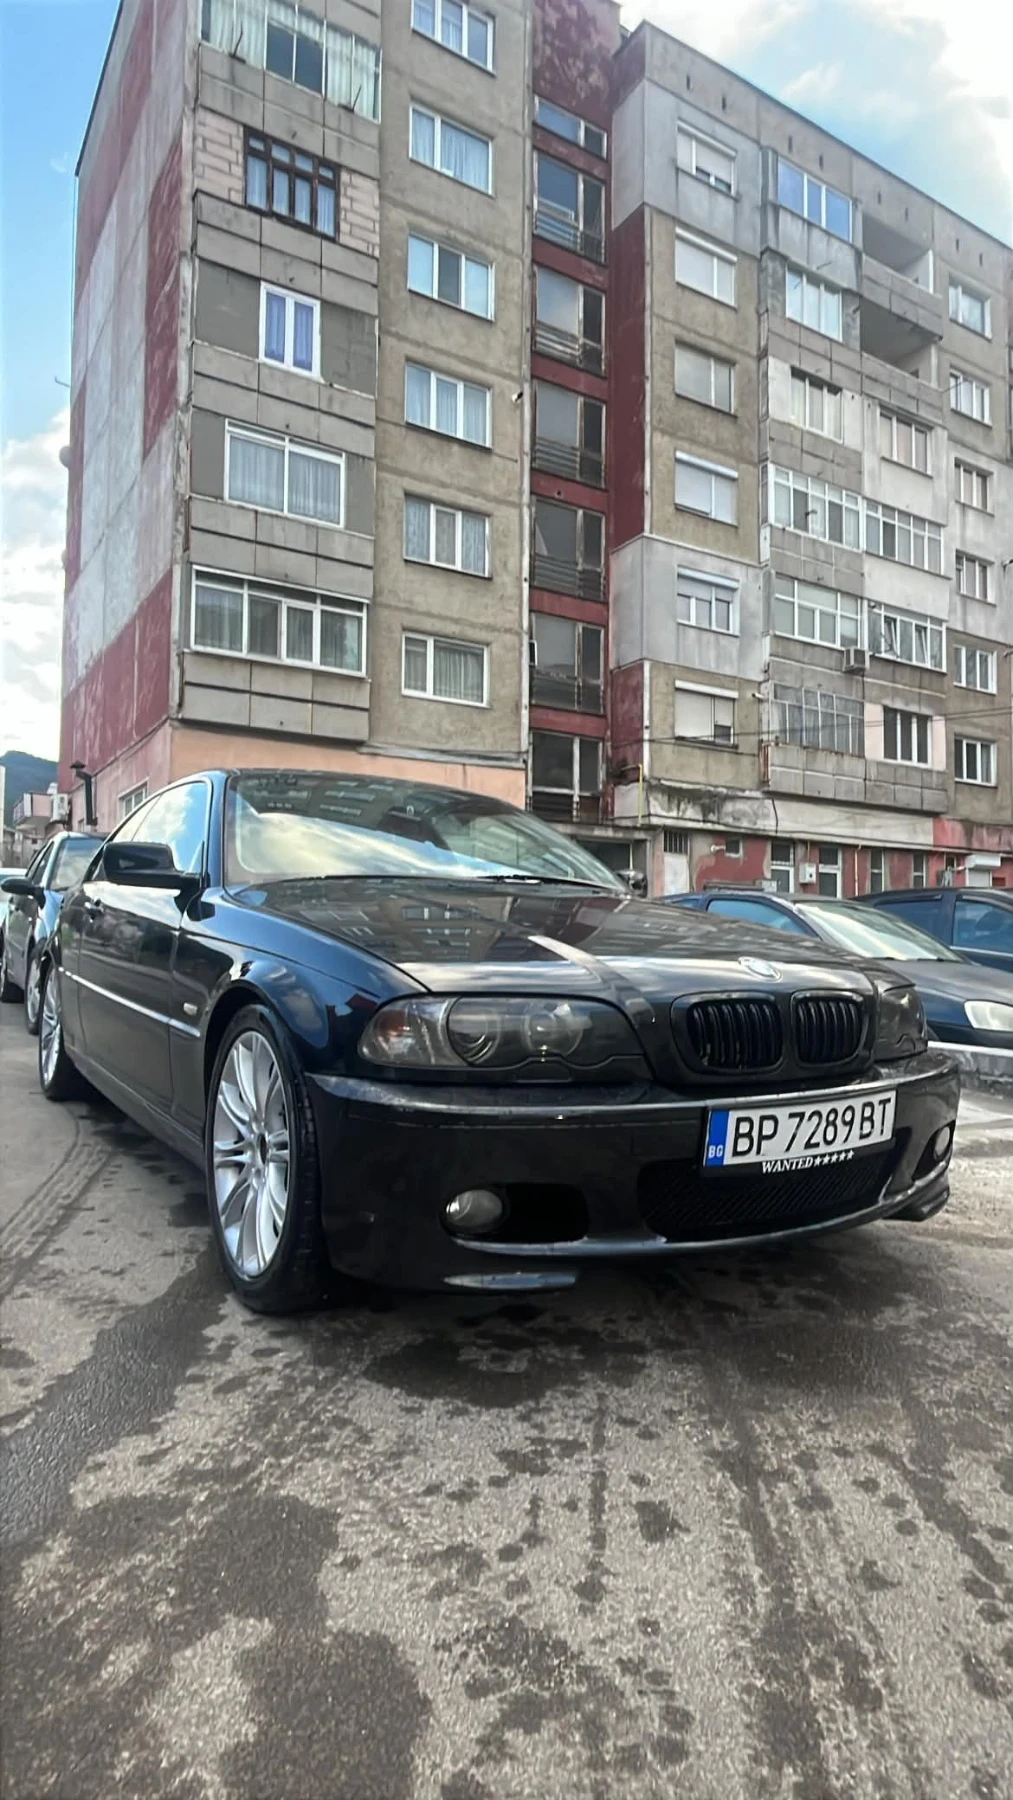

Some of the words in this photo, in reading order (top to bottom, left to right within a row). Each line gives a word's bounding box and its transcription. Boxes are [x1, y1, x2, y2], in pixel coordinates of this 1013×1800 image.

[732, 1114, 779, 1157] BP
[785, 1105, 855, 1153] 7289
[859, 1097, 891, 1140] BT
[708, 1145, 723, 1158] BG
[762, 1156, 813, 1174] WANTED
